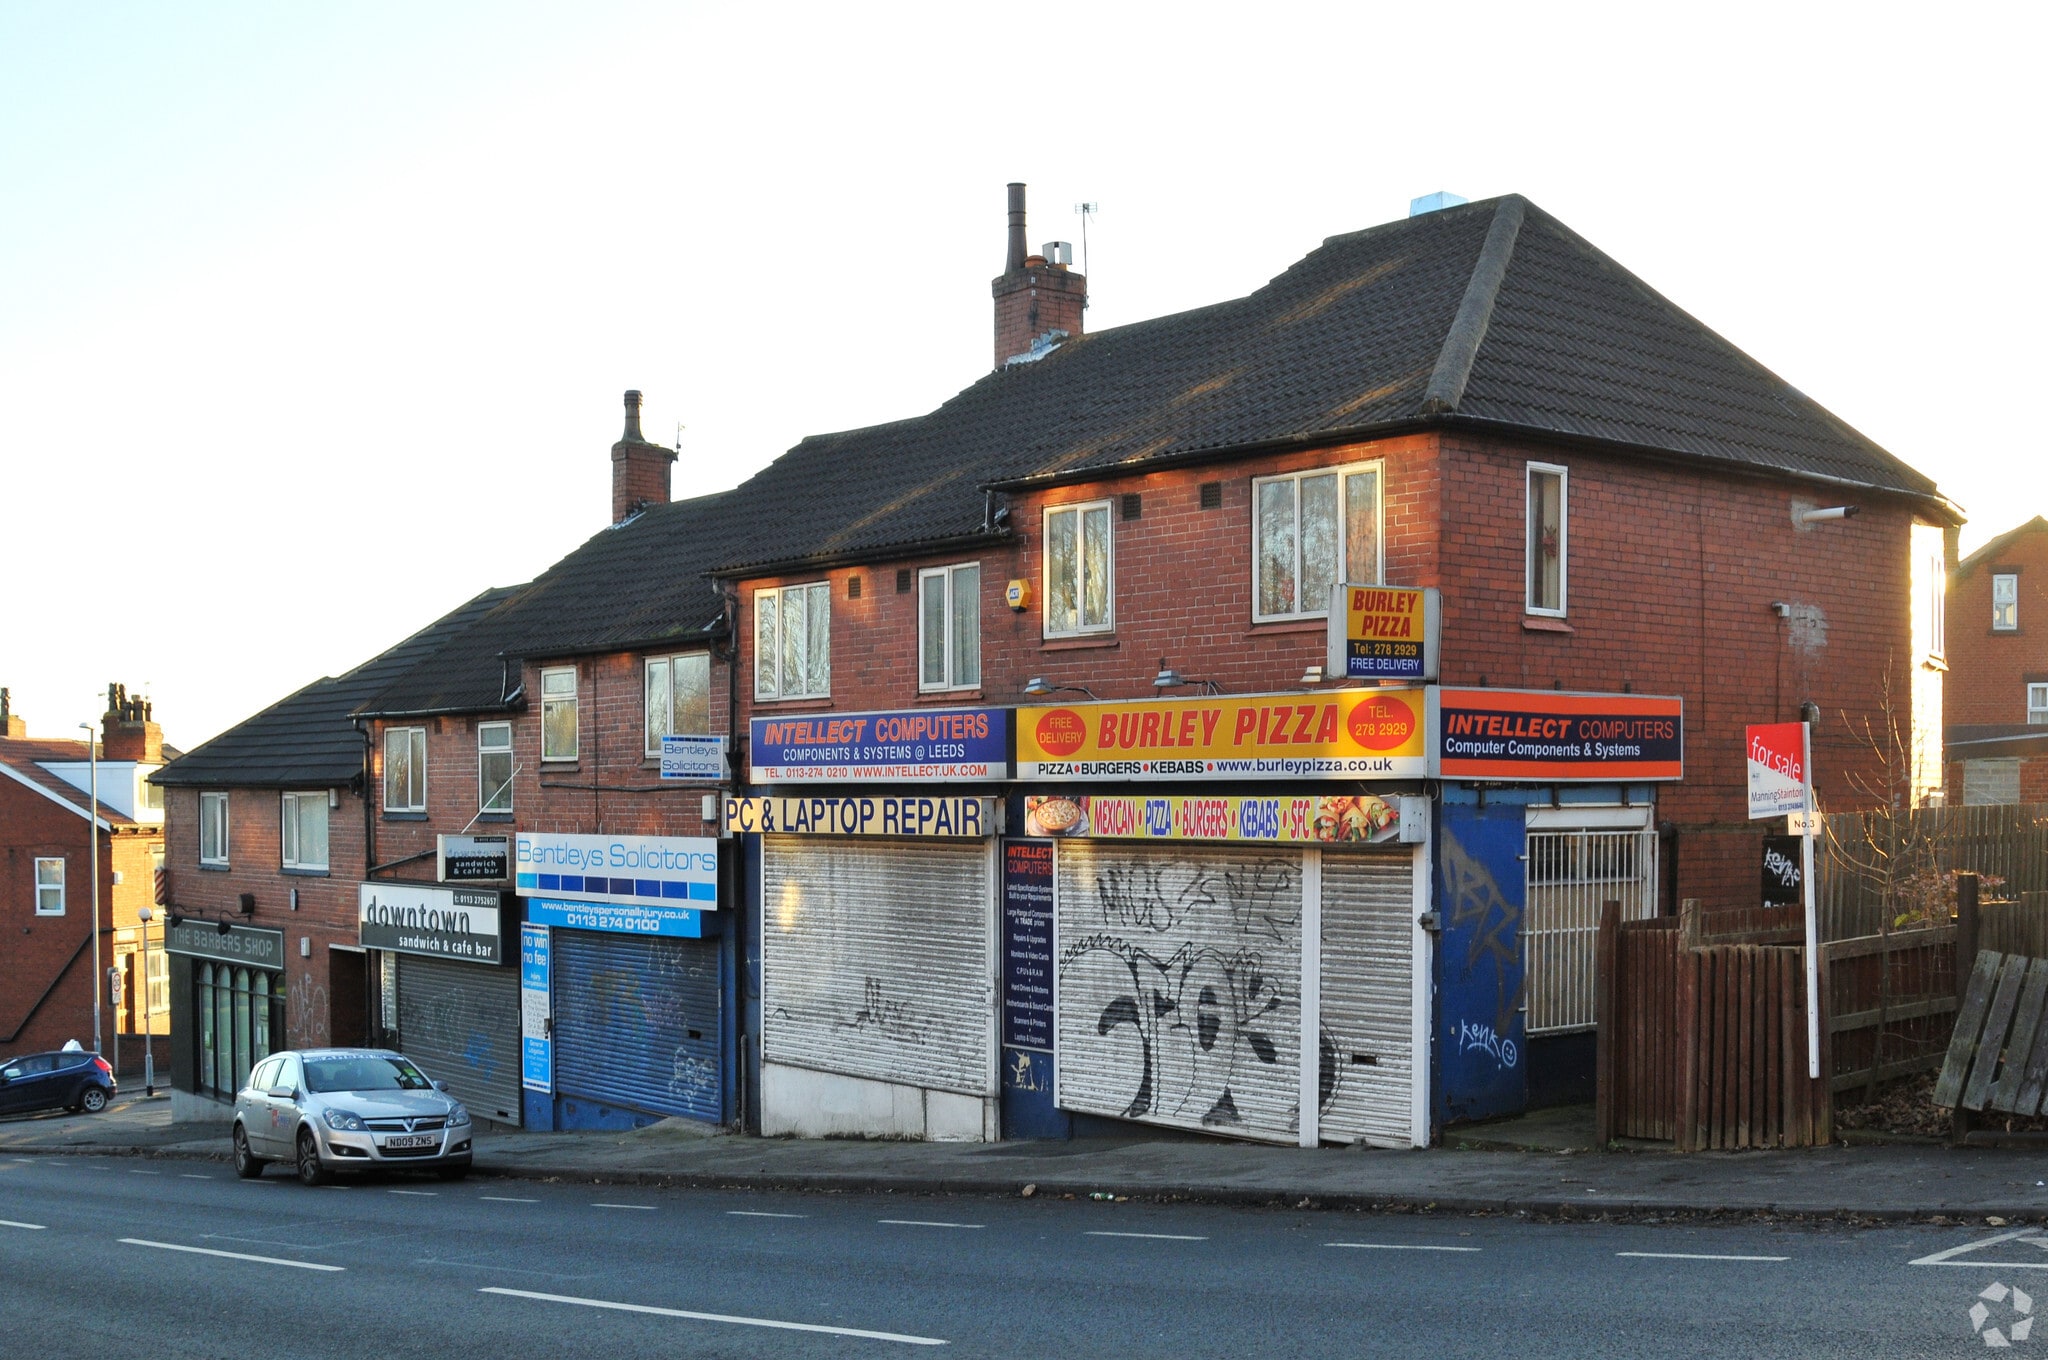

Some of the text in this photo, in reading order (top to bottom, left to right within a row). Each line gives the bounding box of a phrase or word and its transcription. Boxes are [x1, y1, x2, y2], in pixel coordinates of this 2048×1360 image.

[1353, 590, 1418, 613] BURLEY
[1361, 615, 1411, 638] PIZZA
[1354, 643, 1416, 656] Tel: 278 2929
[1350, 658, 1419, 670] FREE DELIVERY
[1369, 705, 1394, 718] TEL.
[764, 713, 989, 745] INTELLECT COMPUTERS
[1049, 717, 1072, 729] FREE
[1098, 704, 1338, 749] BURLEY PIZZA
[1356, 723, 1408, 736] 278 2929
[1447, 714, 1674, 740] INTELLECT COMPUTERS
[1039, 732, 1082, 744] DELIVERY
[664, 744, 718, 757] Bentleys
[783, 744, 965, 762] COMPONENTS & SYSTEMS @ LEEDS
[1446, 738, 1640, 759] Computer Components & Systems
[663, 760, 720, 771] Solicitors
[1038, 758, 1392, 775] PIZZA BURGERS KEBABS www.burleypizza.co.uk
[1752, 736, 1800, 781] for sale
[764, 765, 987, 778] TEL. 0113-274 0210 WWW.INTELLECT.UK.COM
[1751, 788, 1803, 804] ManningStainton
[726, 798, 981, 835] PC & LAPTOP REPAIR
[1094, 799, 1310, 839] MEXICAN PIZZA BURGERS KEBABS SFC
[1794, 819, 1815, 829] No.3
[518, 840, 716, 872] Bentleys Solicitors
[1008, 846, 1053, 859] INTELLECT
[1008, 860, 1053, 875] COMPUTERS
[460, 895, 473, 904] 0113
[367, 895, 470, 935] downtown
[567, 915, 659, 931] 0113 274 0100
[173, 928, 190, 944] THE
[244, 937, 273, 957] SHOP
[399, 935, 492, 957] sandwich & cafe bar
[524, 934, 548, 949] no win
[523, 950, 546, 966] no fee
[390, 1138, 414, 1147] ND09
